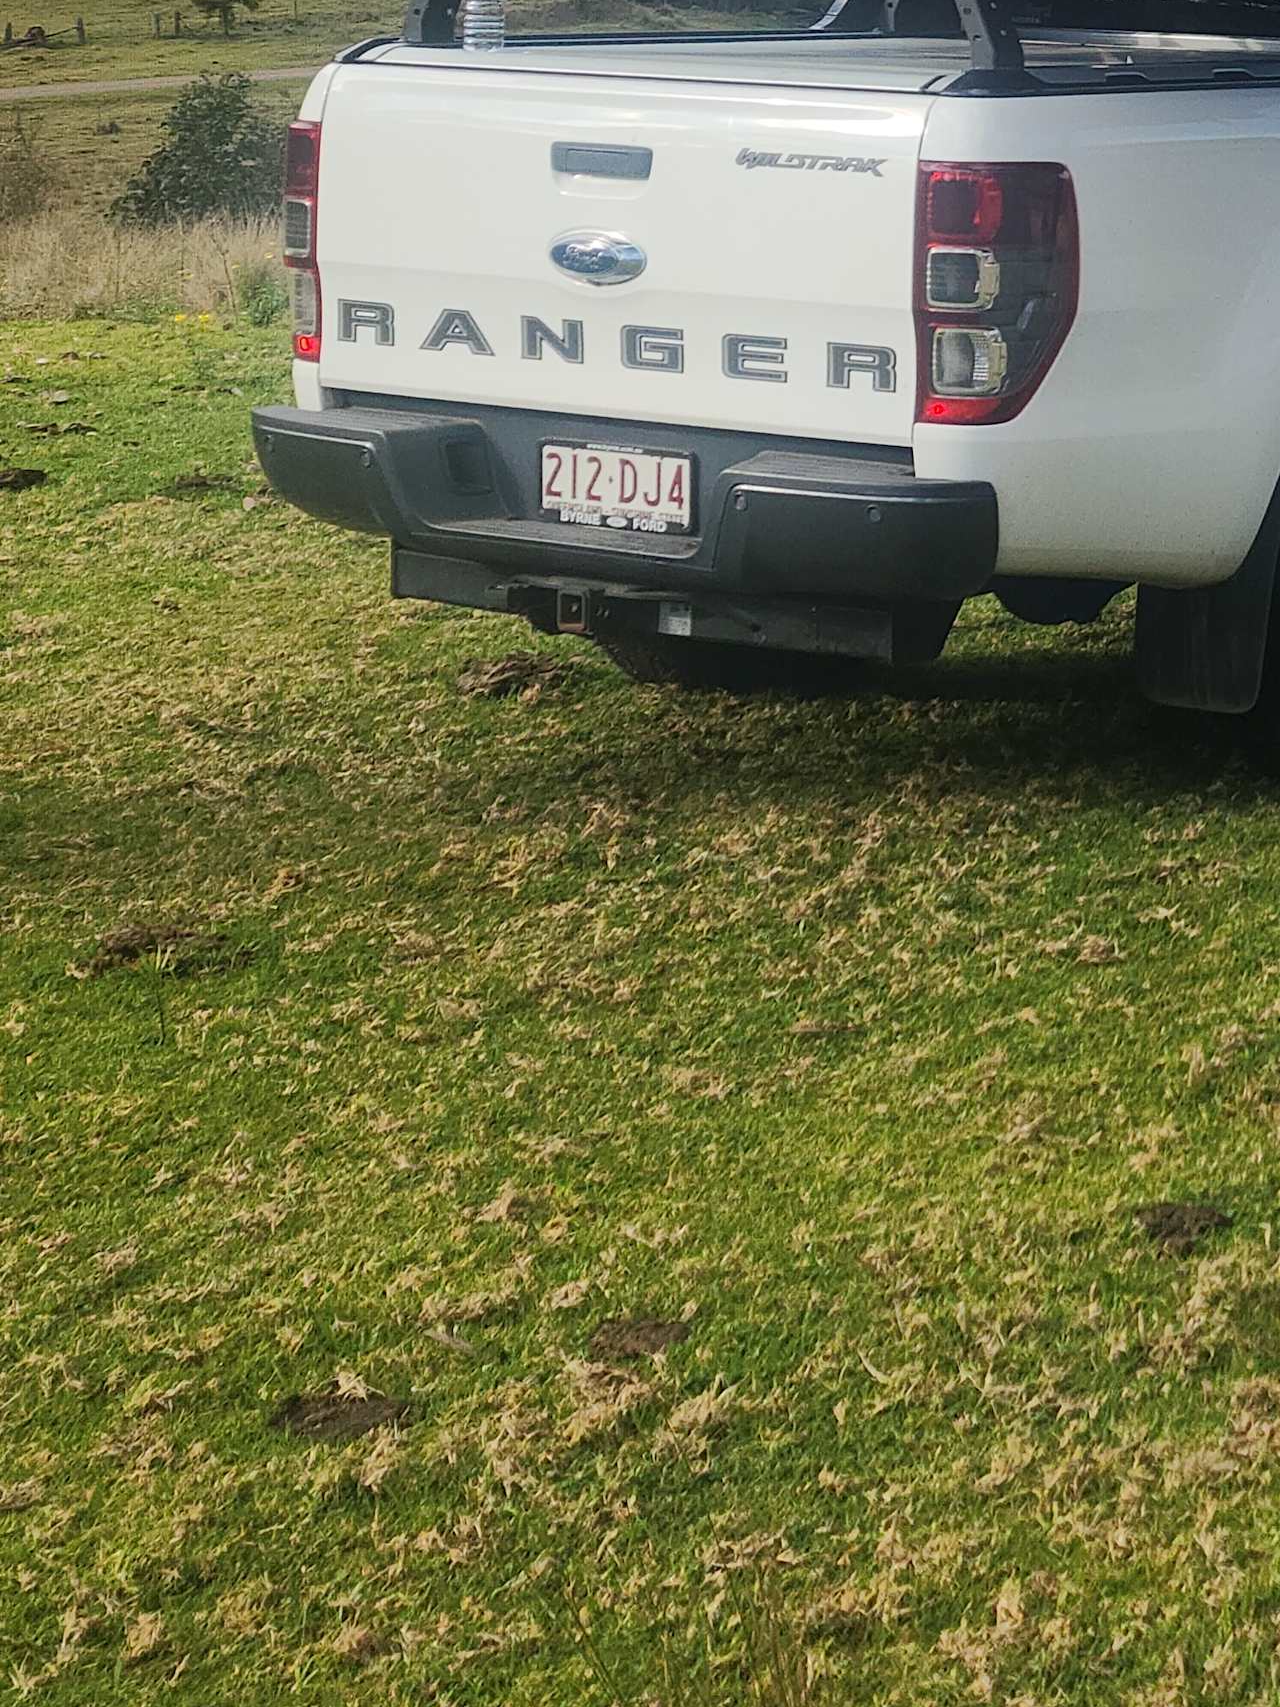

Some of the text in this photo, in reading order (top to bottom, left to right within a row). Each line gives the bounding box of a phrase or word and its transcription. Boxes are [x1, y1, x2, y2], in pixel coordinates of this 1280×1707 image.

[735, 147, 888, 178] WILDTRAK
[337, 298, 896, 393] RANGER
[633, 517, 668, 533] FORD
